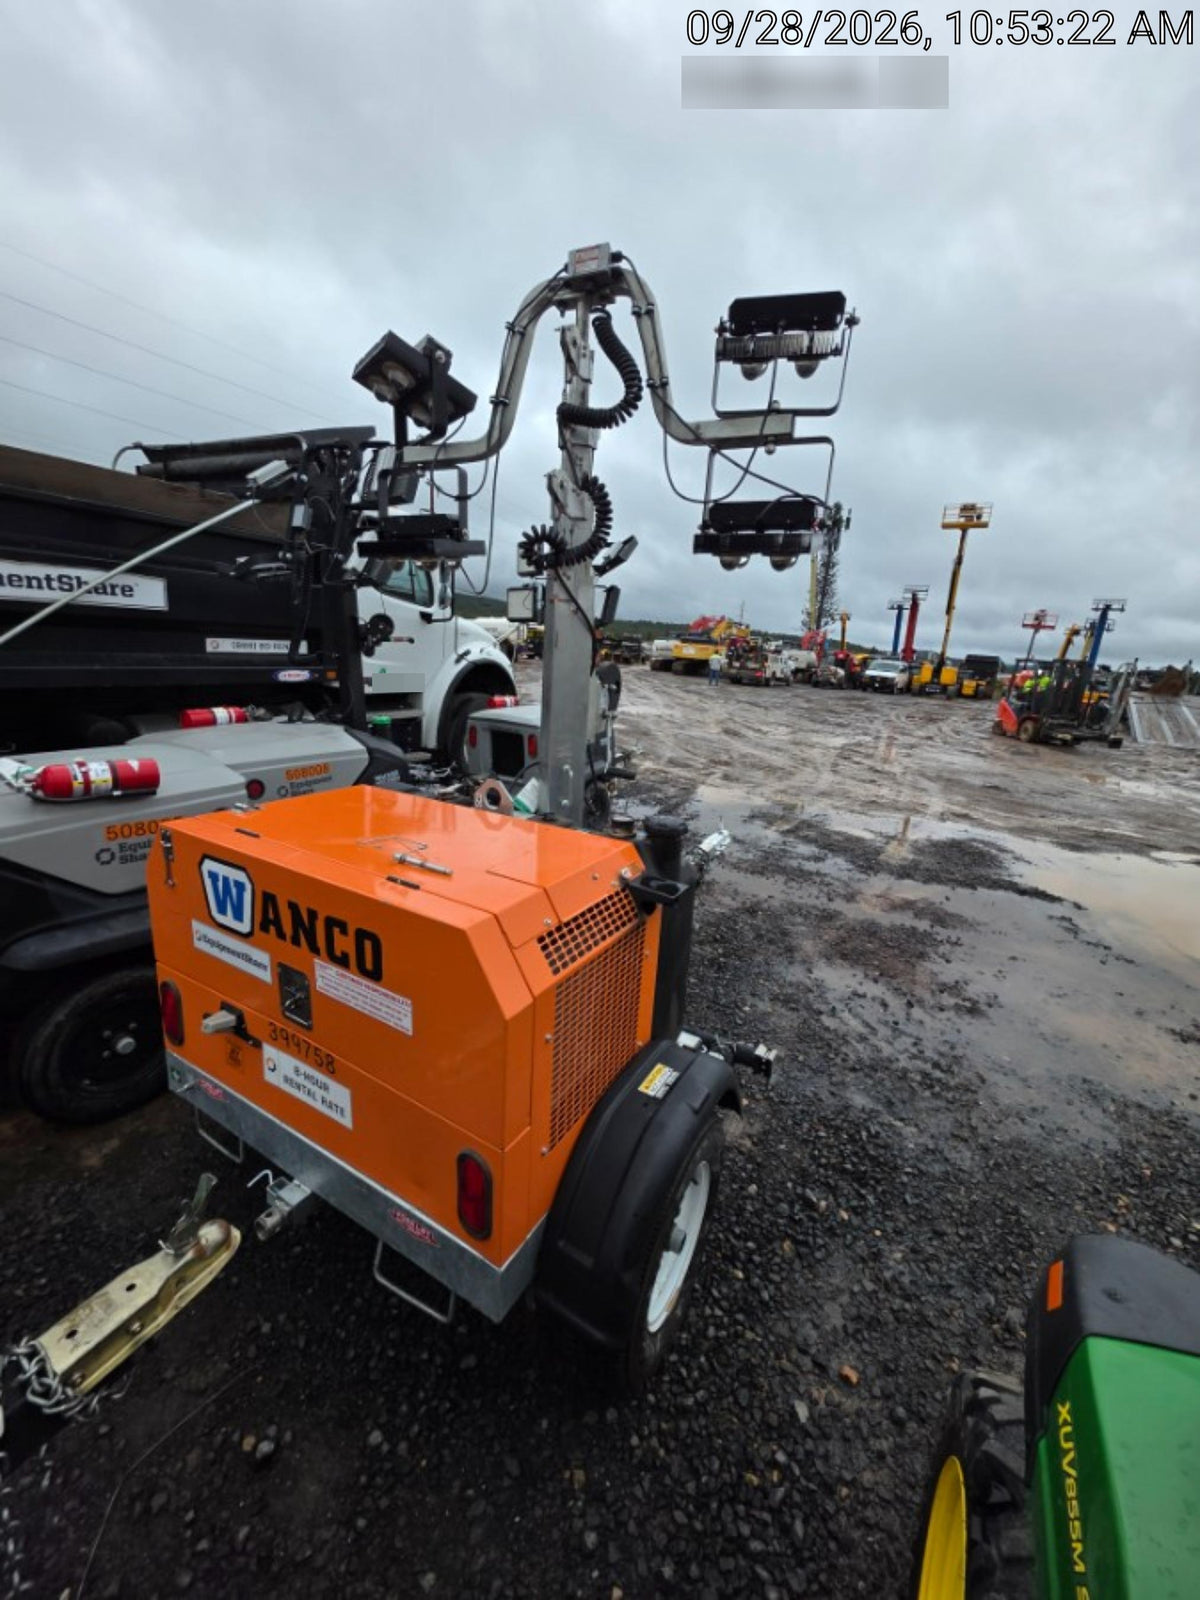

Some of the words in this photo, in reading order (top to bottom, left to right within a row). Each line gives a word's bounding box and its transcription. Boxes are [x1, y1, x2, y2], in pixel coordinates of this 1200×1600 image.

[0, 573, 136, 597] entShare
[105, 819, 160, 841] 5080
[206, 868, 384, 983] WANCO
